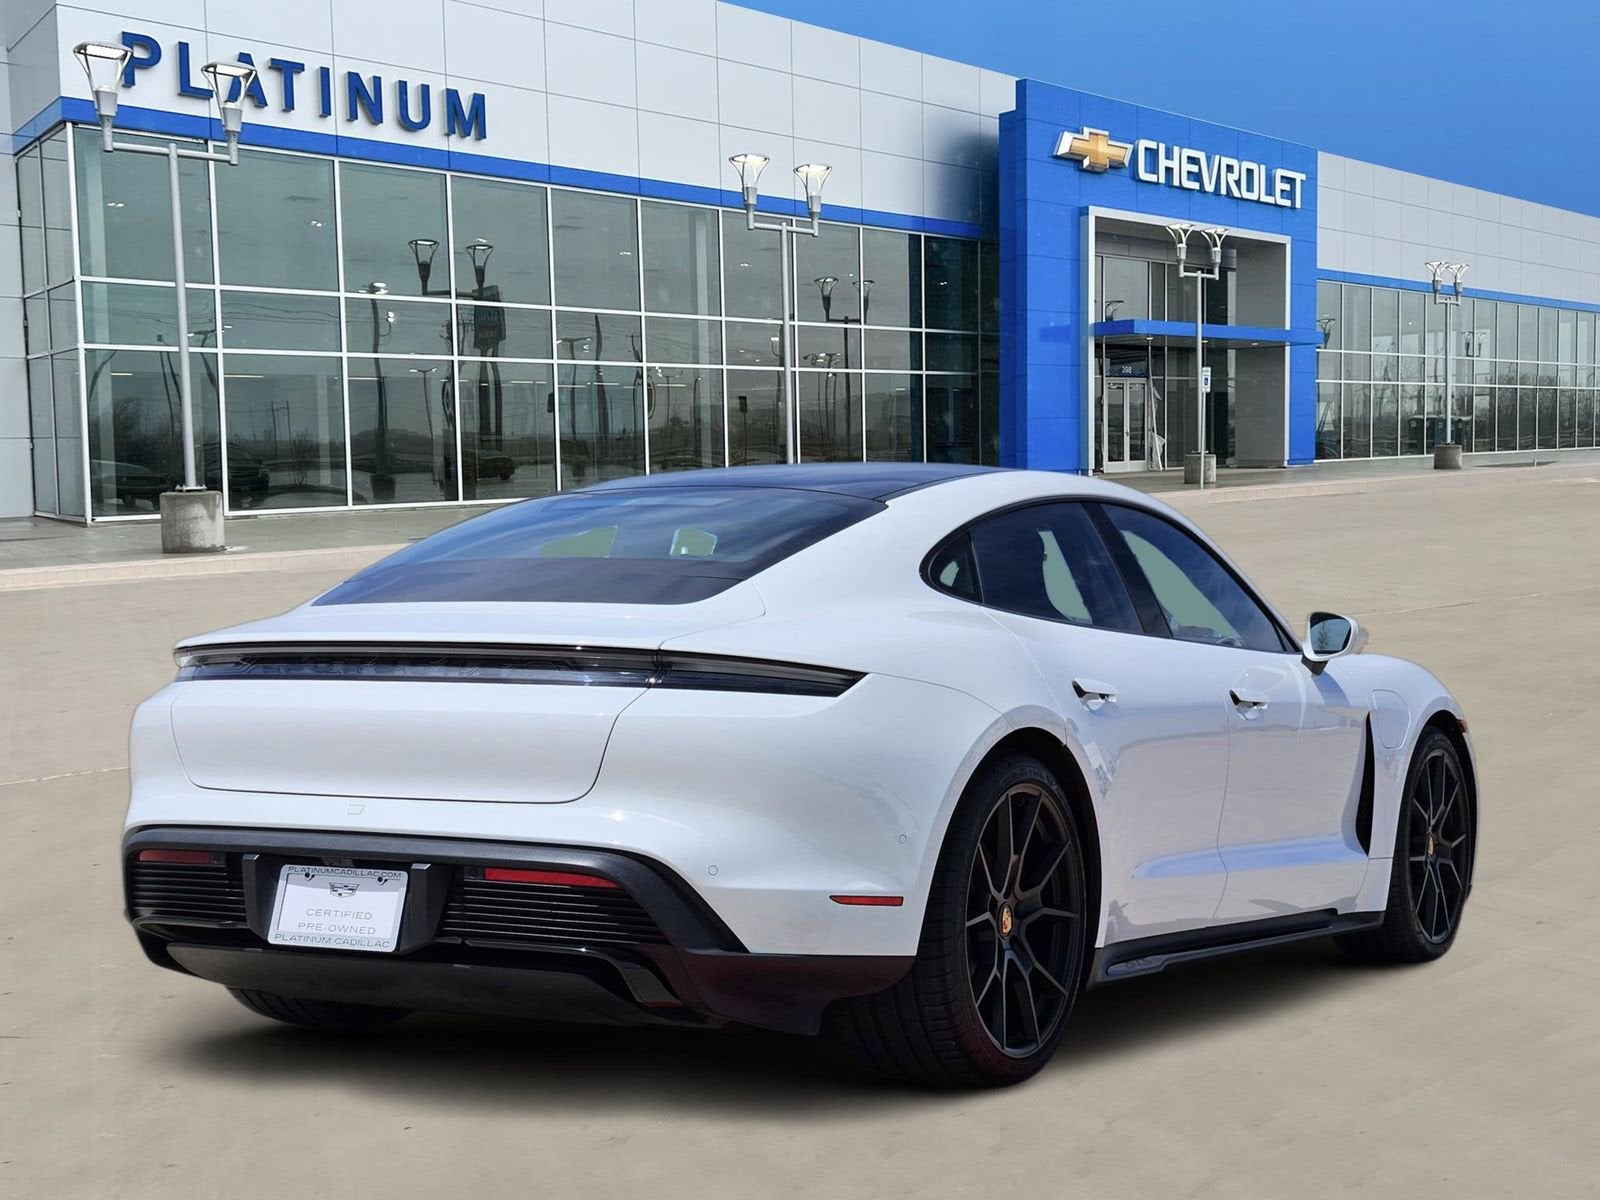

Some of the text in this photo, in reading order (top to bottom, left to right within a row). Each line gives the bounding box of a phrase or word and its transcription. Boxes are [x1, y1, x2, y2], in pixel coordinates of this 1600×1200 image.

[122, 31, 486, 140] PLATINUM
[1136, 139, 1306, 209] CHEVROLET
[306, 908, 373, 920] CERTIFIED
[298, 922, 376, 935] PRE-OWNED
[275, 934, 391, 948] PLATINUM CADILLAC
